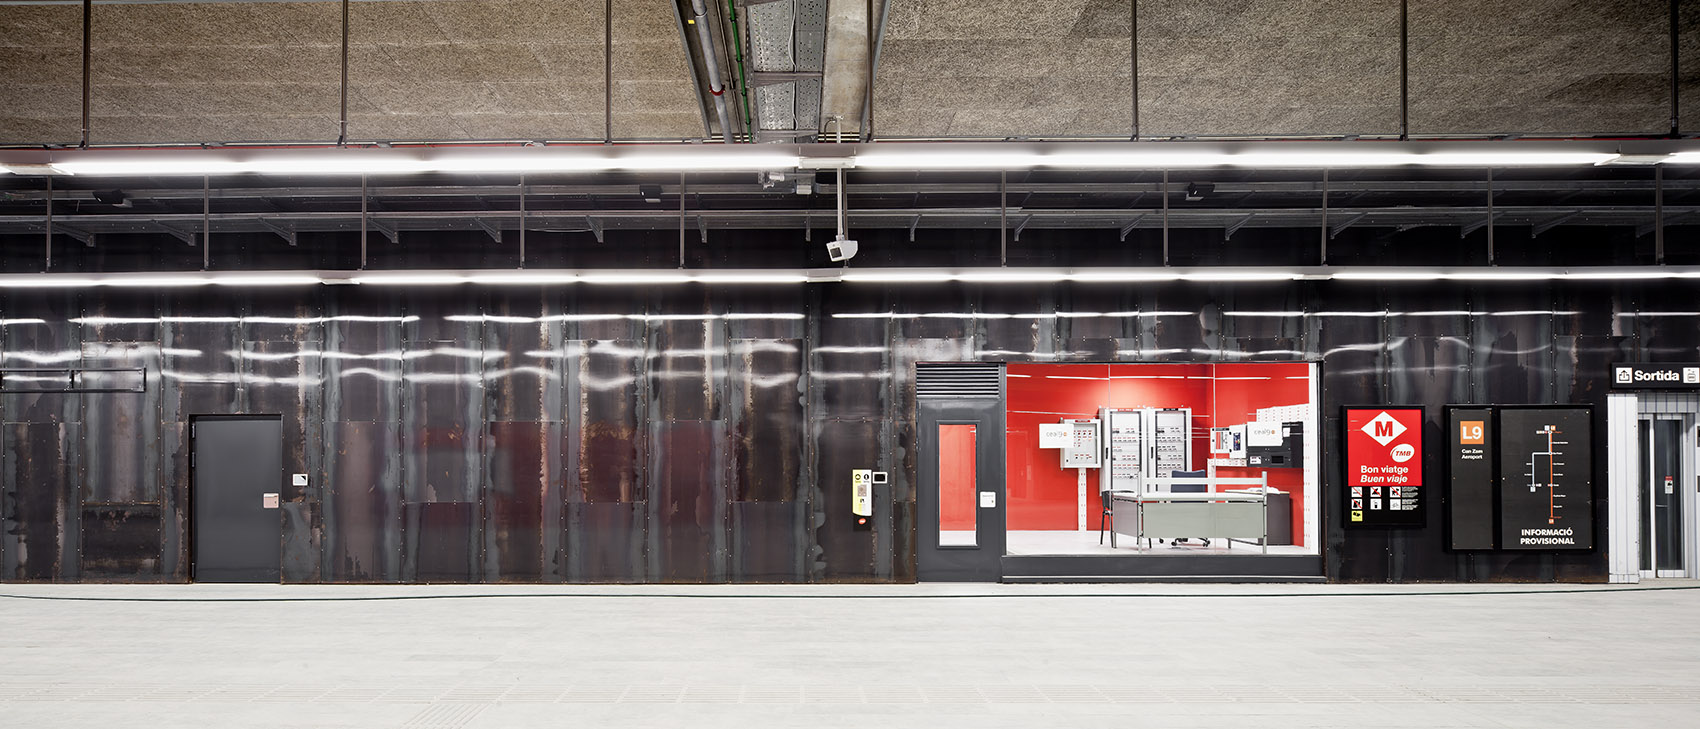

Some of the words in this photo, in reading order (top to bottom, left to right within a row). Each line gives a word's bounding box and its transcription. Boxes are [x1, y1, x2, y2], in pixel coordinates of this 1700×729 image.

[1634, 370, 1680, 381] Sortida
[1375, 421, 1393, 437] M
[1462, 426, 1482, 440] L9
[1360, 465, 1379, 474] Bon
[1380, 465, 1408, 474] viatge
[1360, 475, 1384, 483] Buen
[1386, 475, 1408, 484] viaje
[1521, 527, 1573, 536] INFORMACIÓ
[1520, 537, 1575, 545] PROVISIONAL
